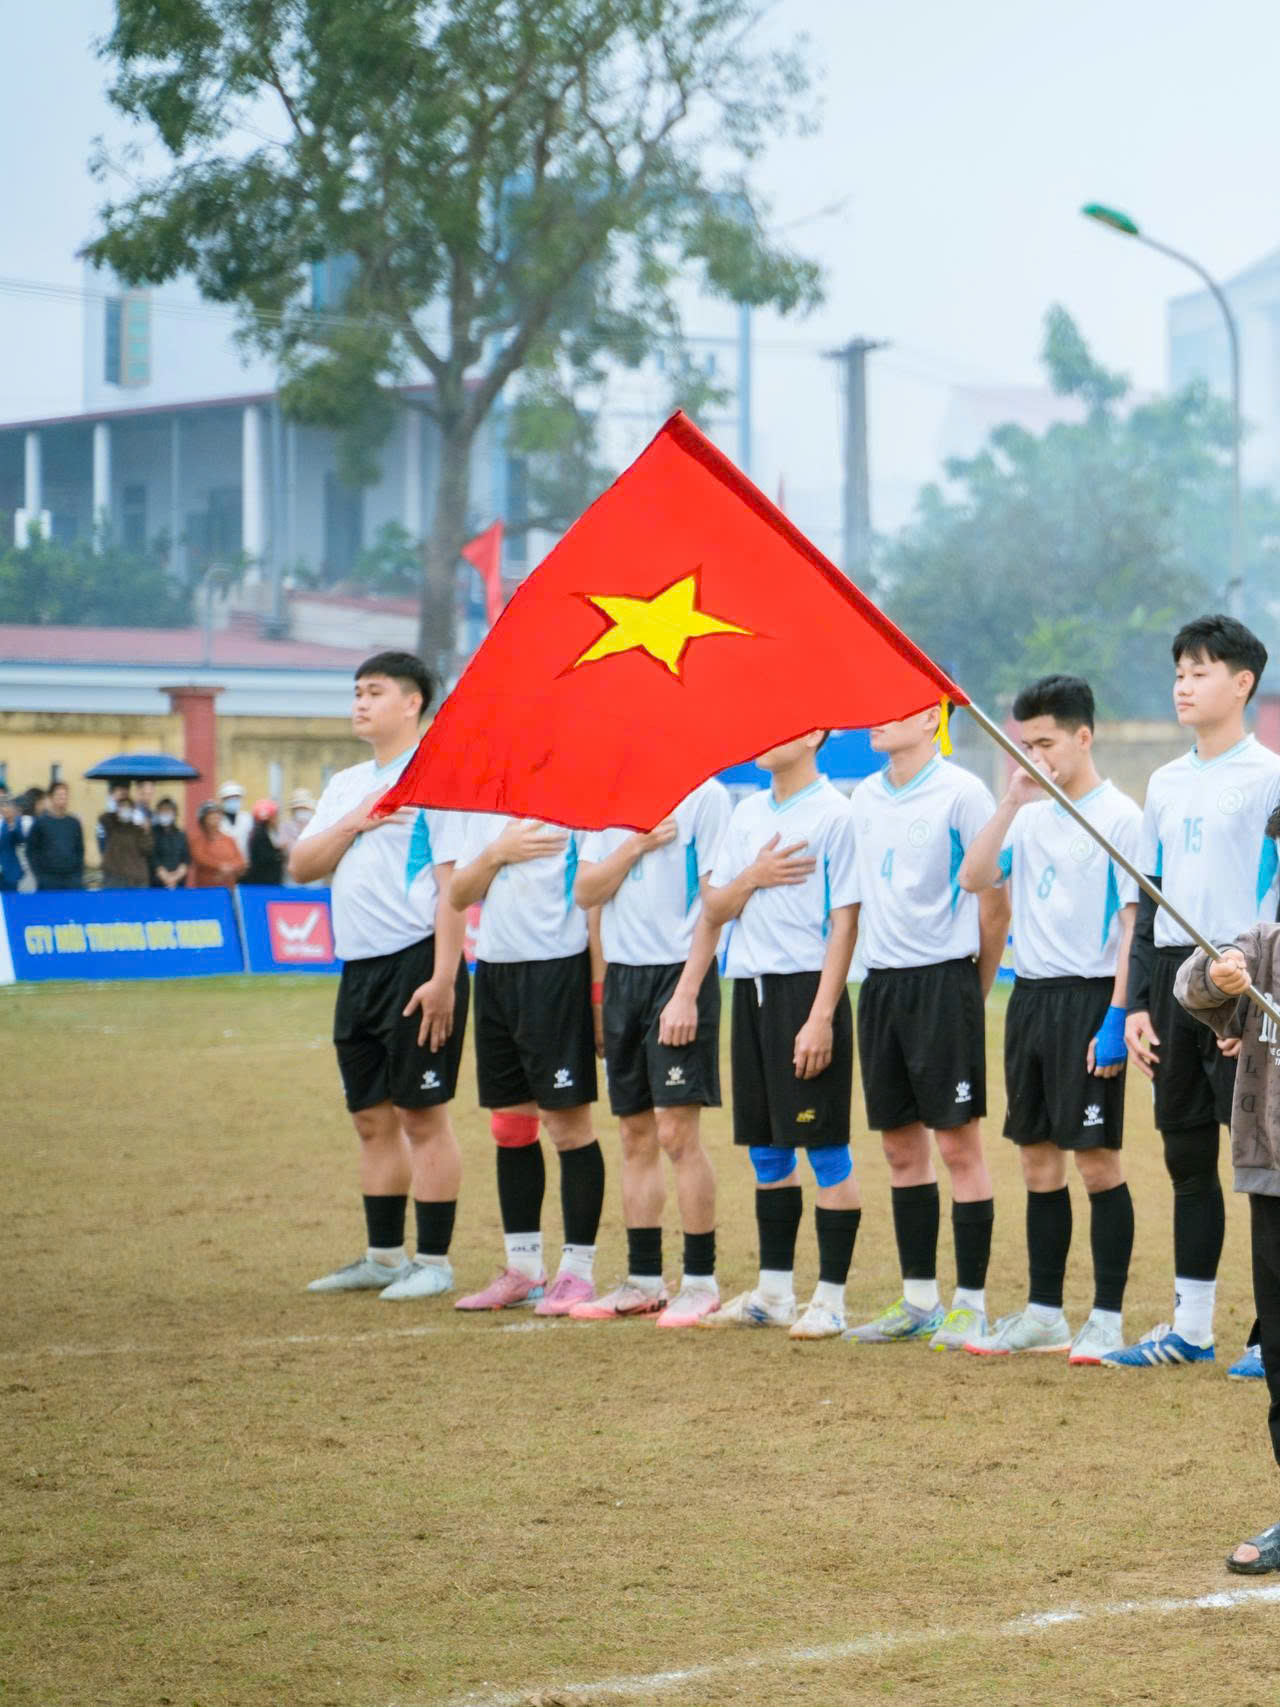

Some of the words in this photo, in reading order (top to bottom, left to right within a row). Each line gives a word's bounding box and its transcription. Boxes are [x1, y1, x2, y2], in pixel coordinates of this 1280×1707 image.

[1183, 816, 1203, 853] 15
[880, 848, 895, 882] 4
[1038, 864, 1055, 900] 8
